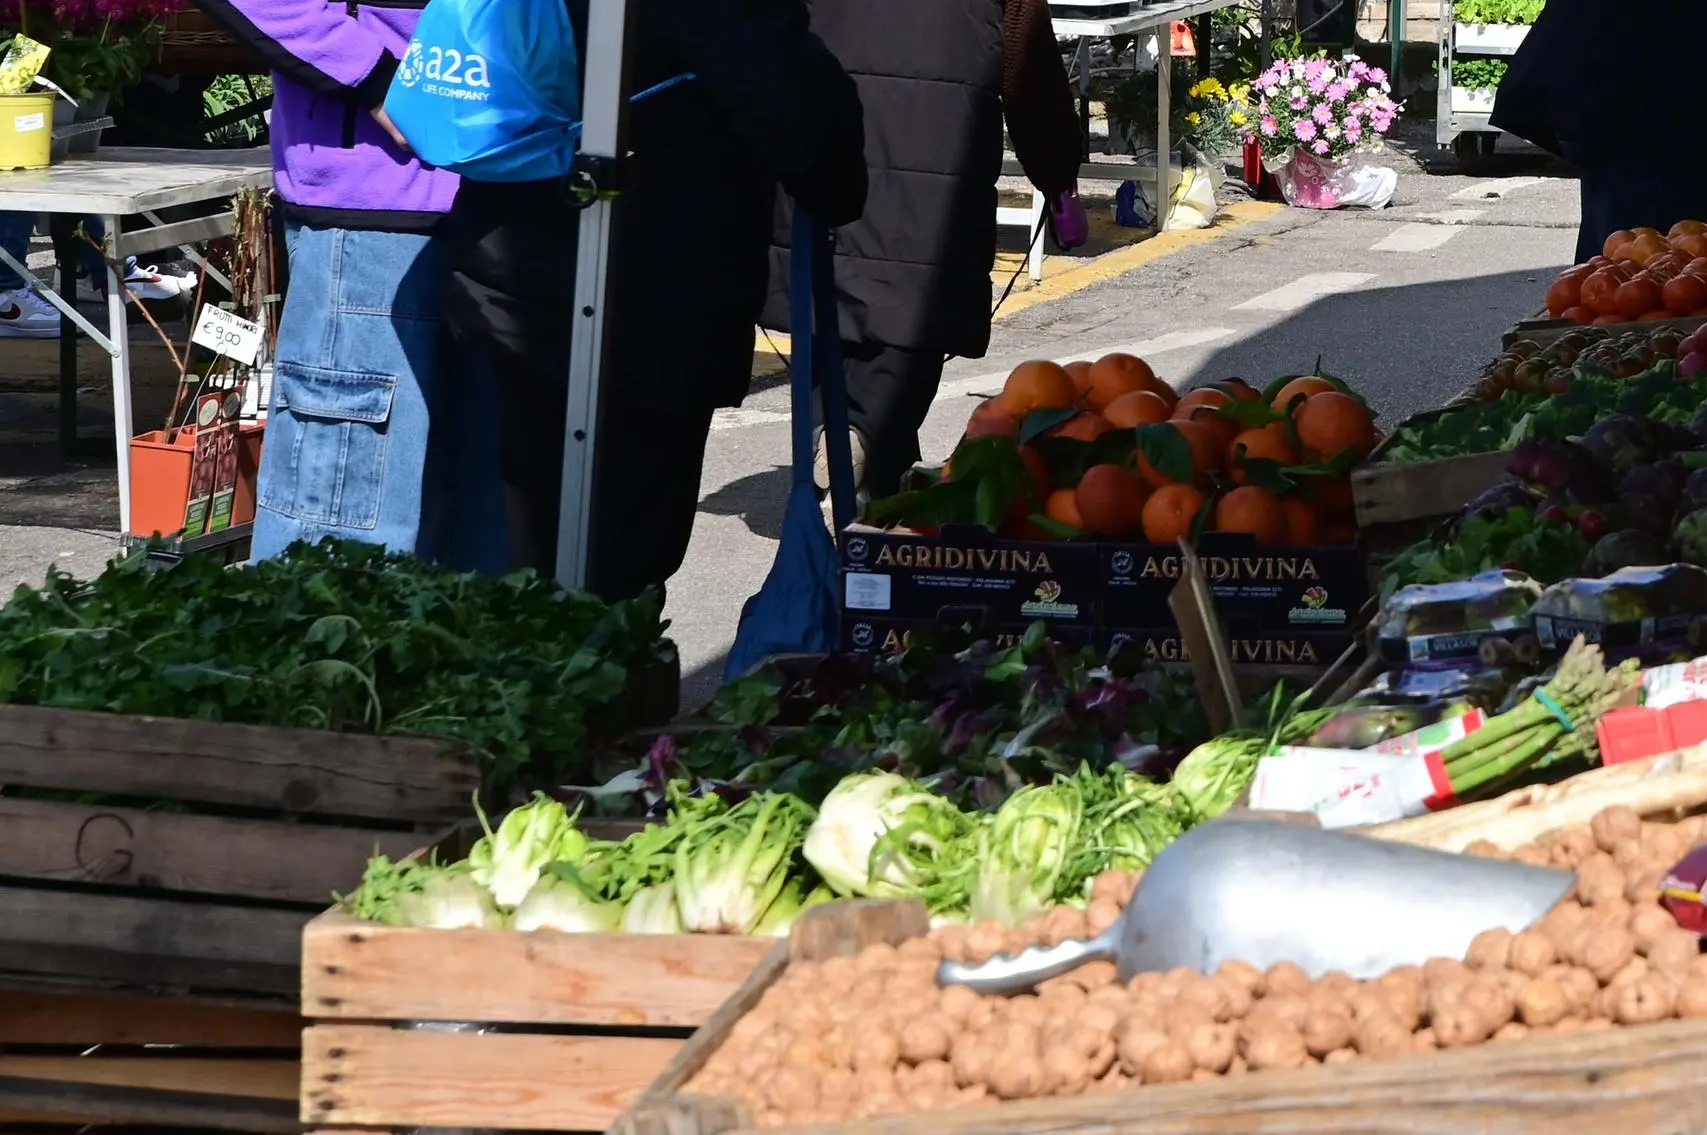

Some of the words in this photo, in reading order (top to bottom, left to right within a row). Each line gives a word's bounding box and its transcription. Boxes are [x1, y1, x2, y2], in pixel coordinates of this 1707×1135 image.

[425, 45, 491, 88] a2a
[438, 86, 491, 101] COMPANY
[875, 543, 1054, 574] AGRIDIVINA
